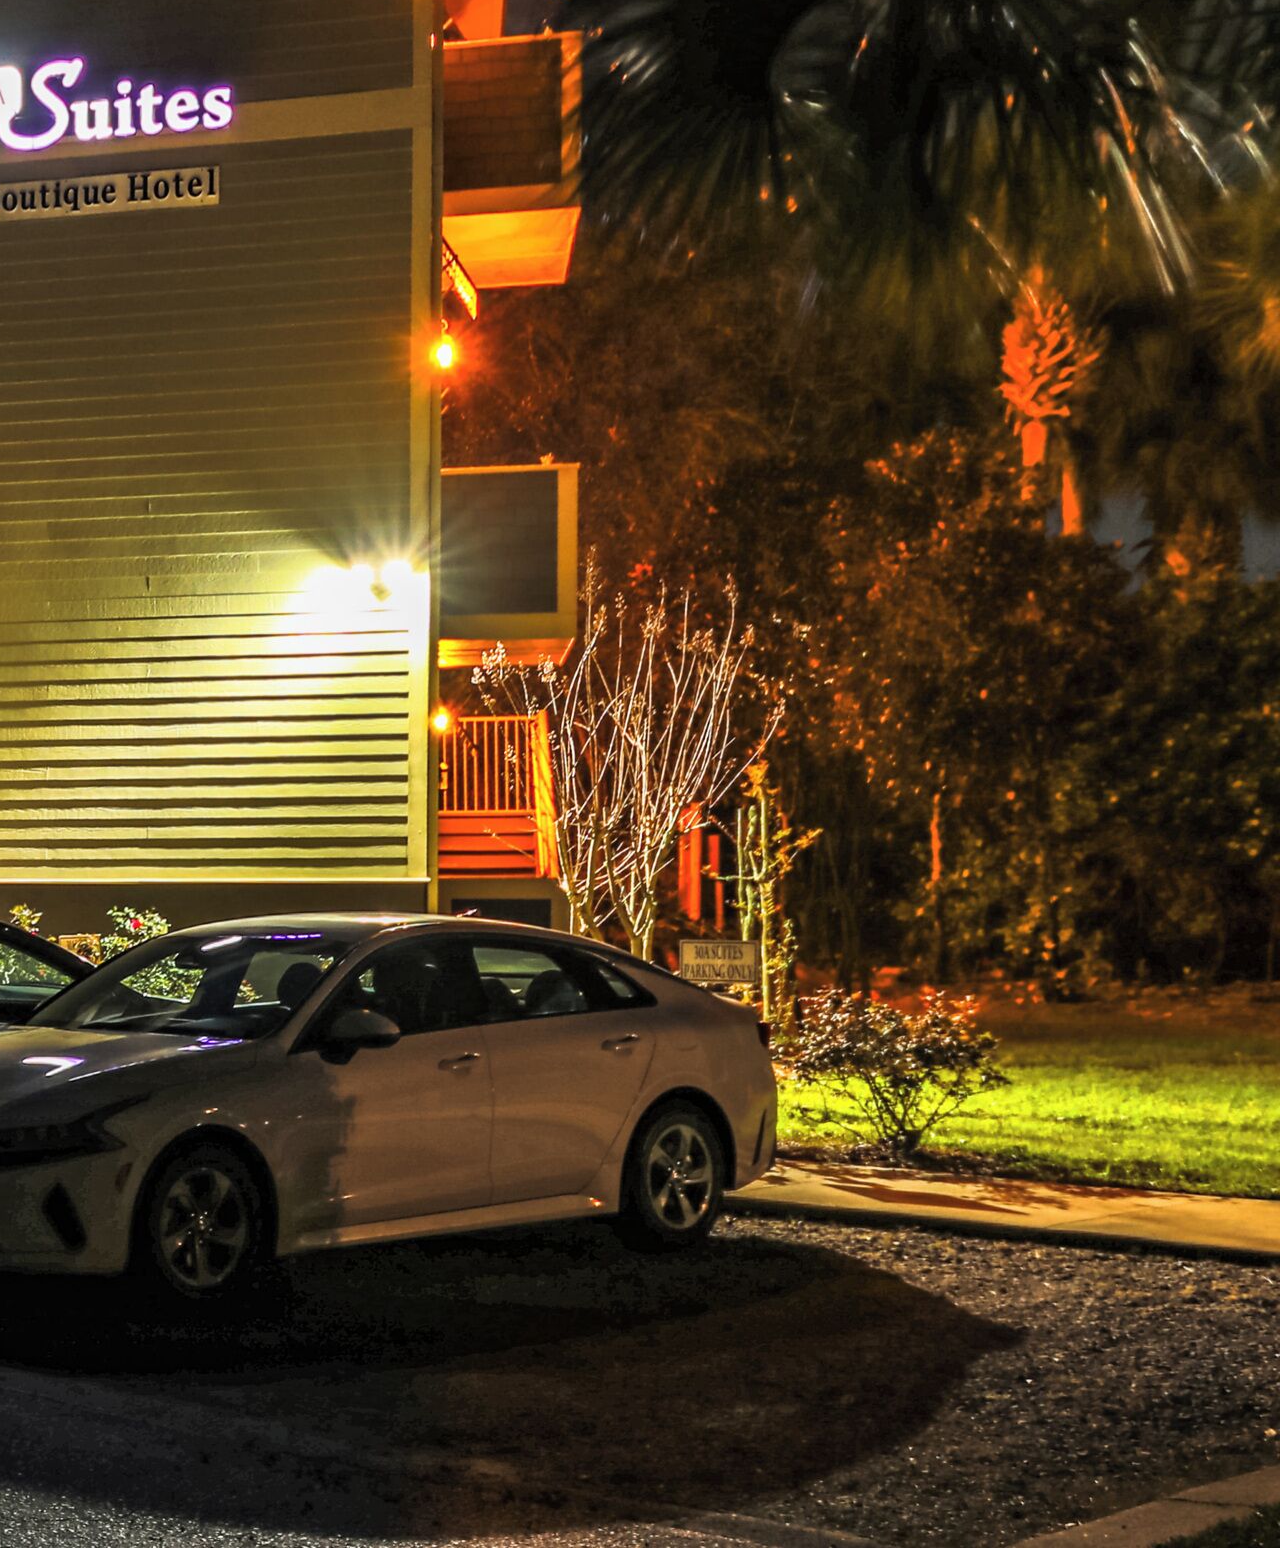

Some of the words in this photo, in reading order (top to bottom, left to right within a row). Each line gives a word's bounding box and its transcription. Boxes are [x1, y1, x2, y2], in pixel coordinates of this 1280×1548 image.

[127, 168, 217, 203] Hotel
[694, 944, 710, 960] 30A
[711, 944, 744, 960] SUITES
[684, 963, 725, 979] PARKING
[727, 963, 754, 980] ONLY
